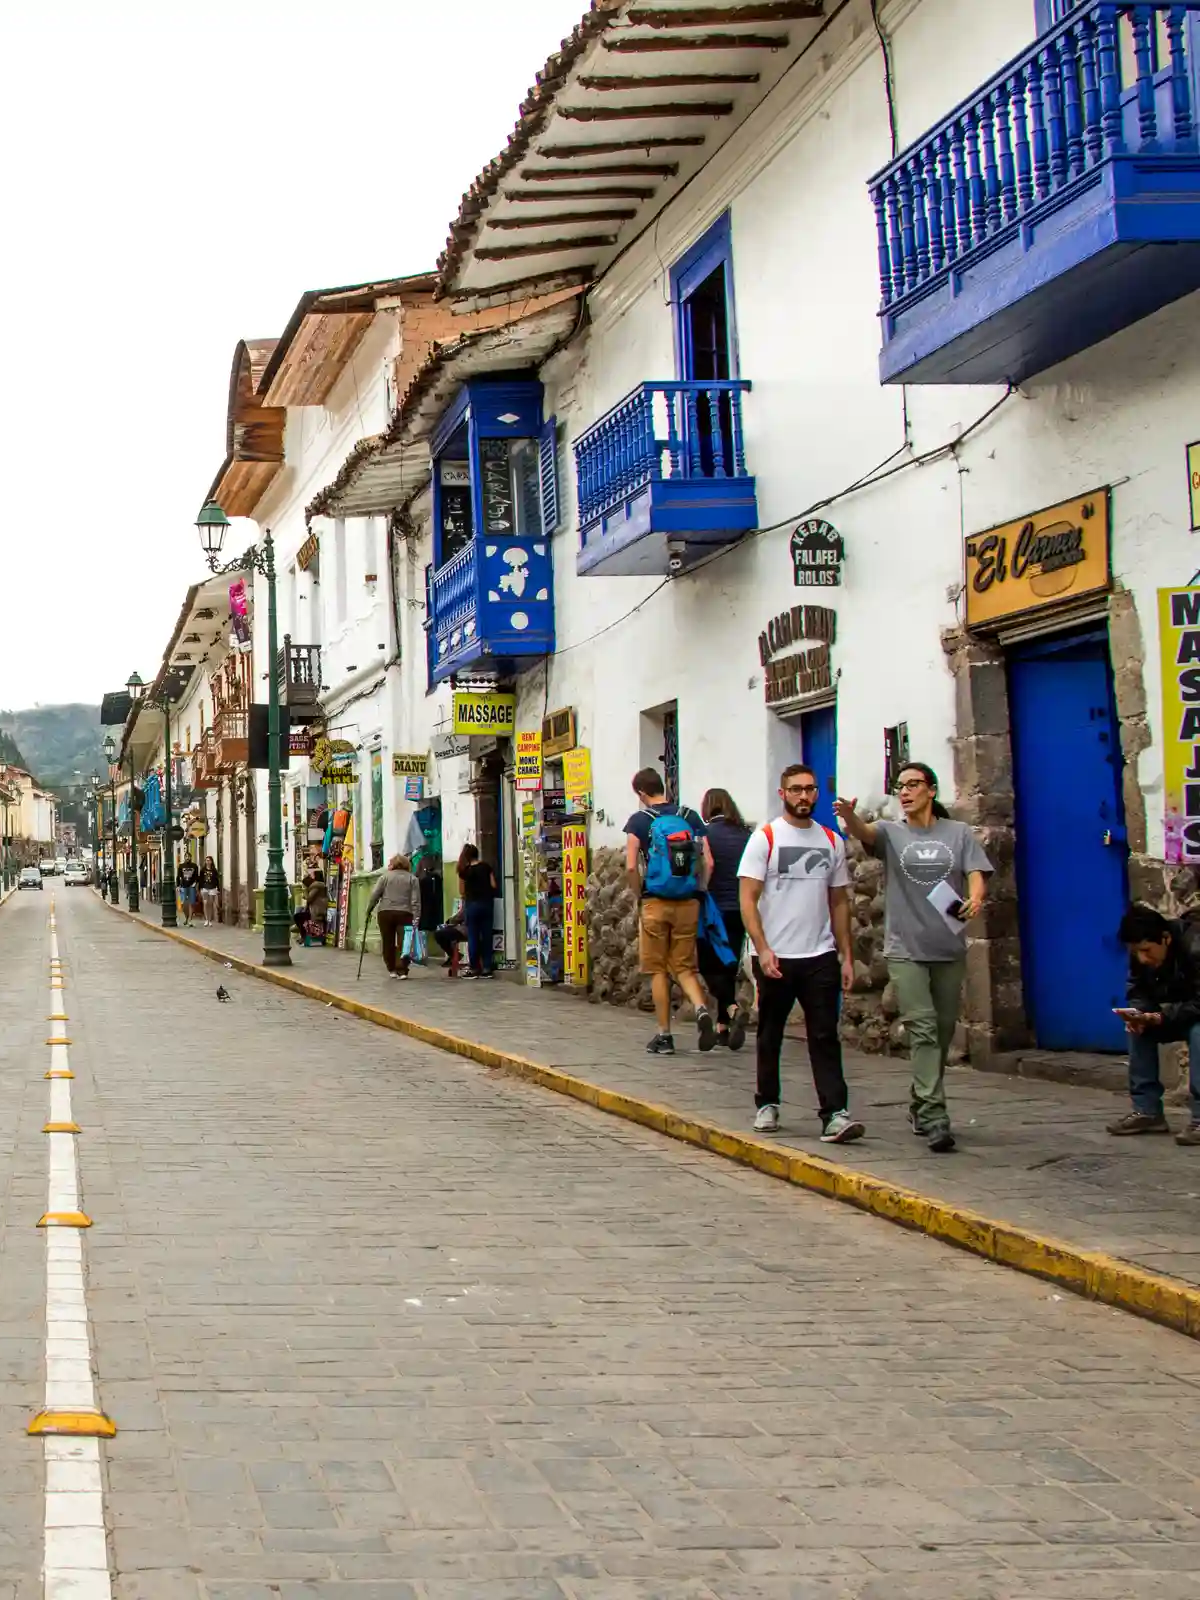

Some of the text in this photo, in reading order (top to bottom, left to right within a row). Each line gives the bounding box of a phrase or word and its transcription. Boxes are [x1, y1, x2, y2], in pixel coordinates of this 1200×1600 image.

[792, 520, 839, 546] KEBAB
[795, 549, 838, 565] FALAFEL
[458, 704, 513, 723] MASSAGE
[521, 732, 536, 741] RENT
[394, 760, 427, 772] MANU
[519, 755, 538, 765] MONEY
[517, 766, 541, 775] CHANGE
[563, 828, 573, 971] MARKET
[575, 831, 585, 979] MARKET
